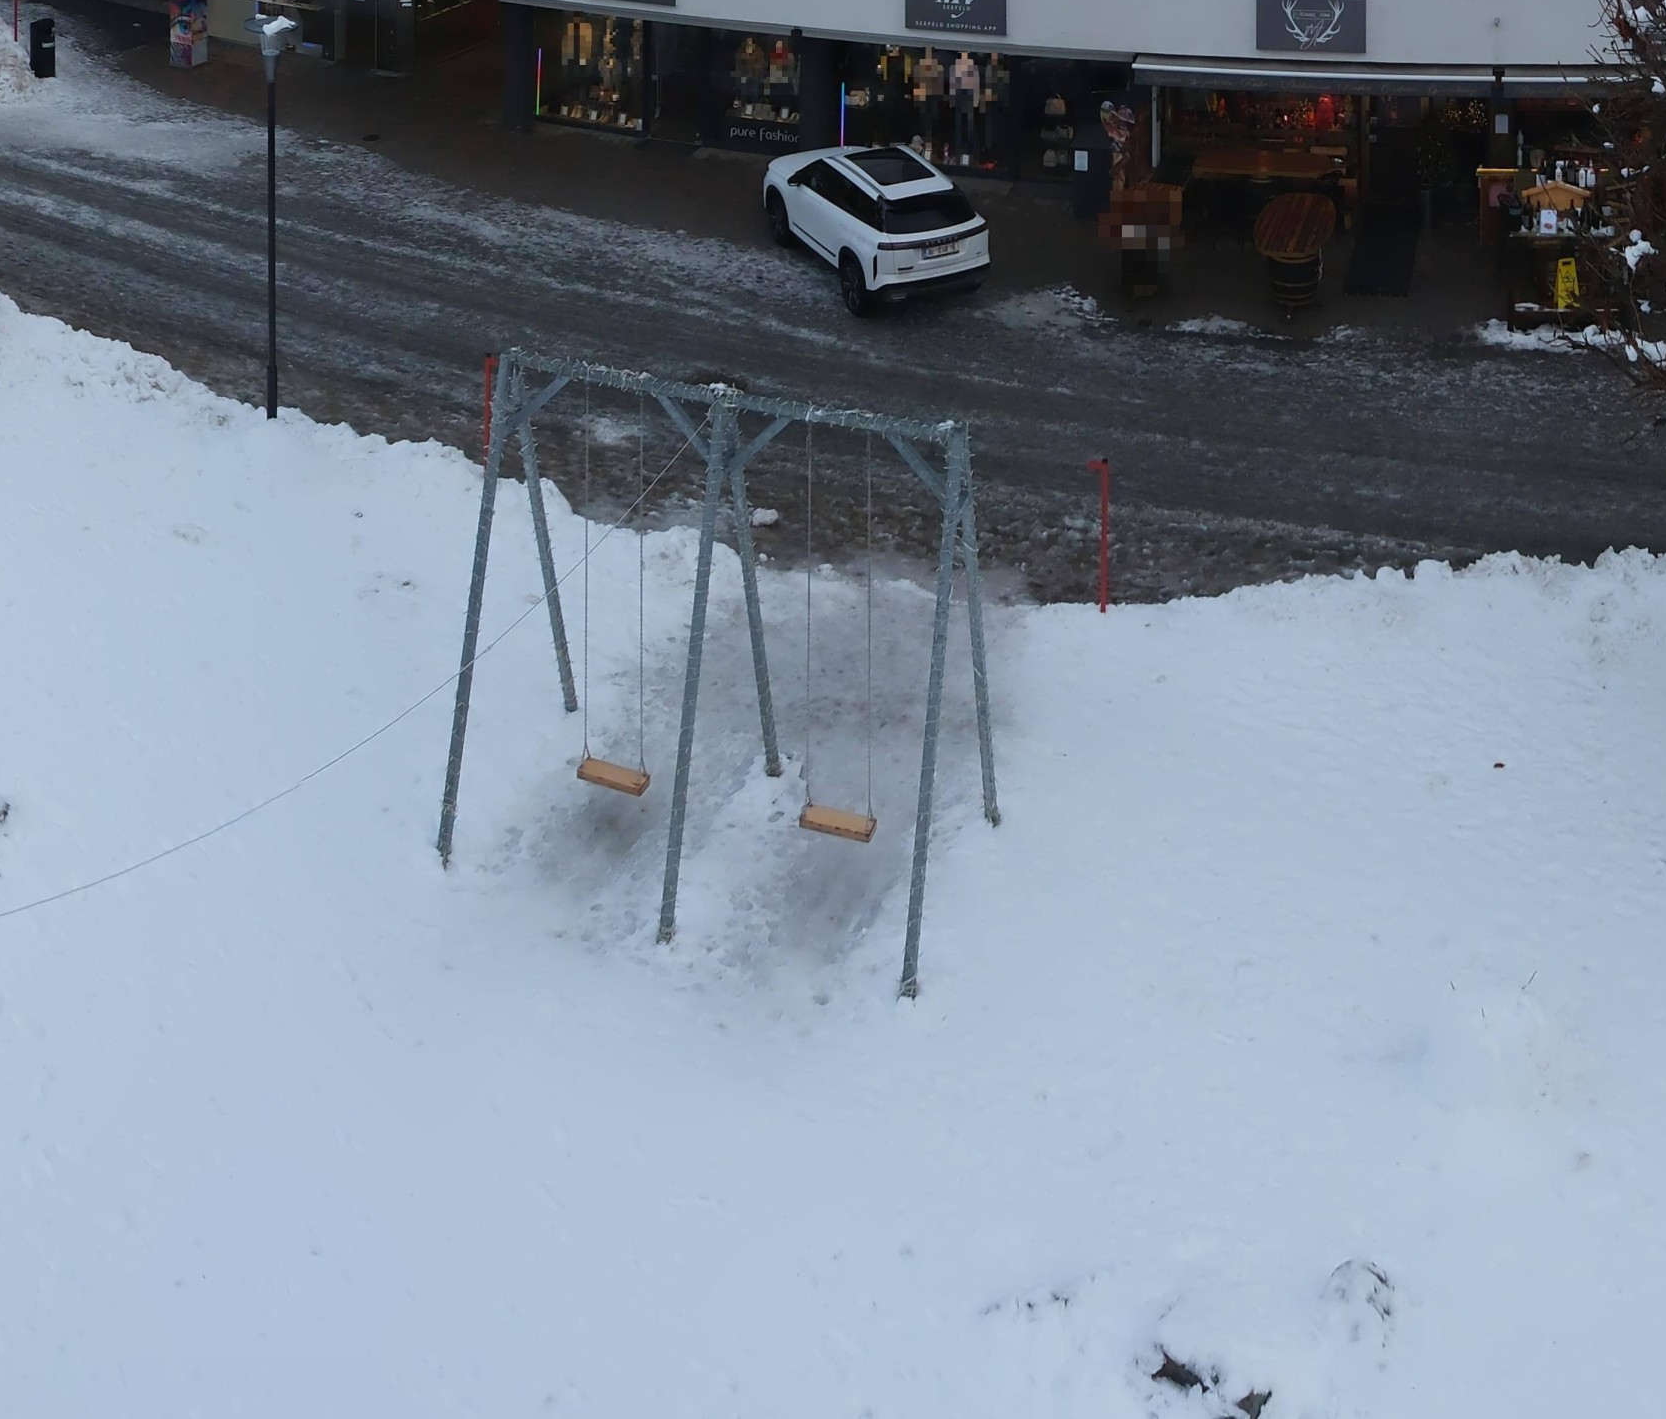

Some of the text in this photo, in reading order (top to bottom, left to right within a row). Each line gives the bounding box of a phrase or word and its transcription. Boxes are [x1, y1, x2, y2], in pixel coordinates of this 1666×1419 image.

[942, 4, 971, 12] SEEFELD
[915, 20, 944, 28] SEEFELD
[946, 22, 981, 31] SHOPPING
[730, 127, 756, 138] pure
